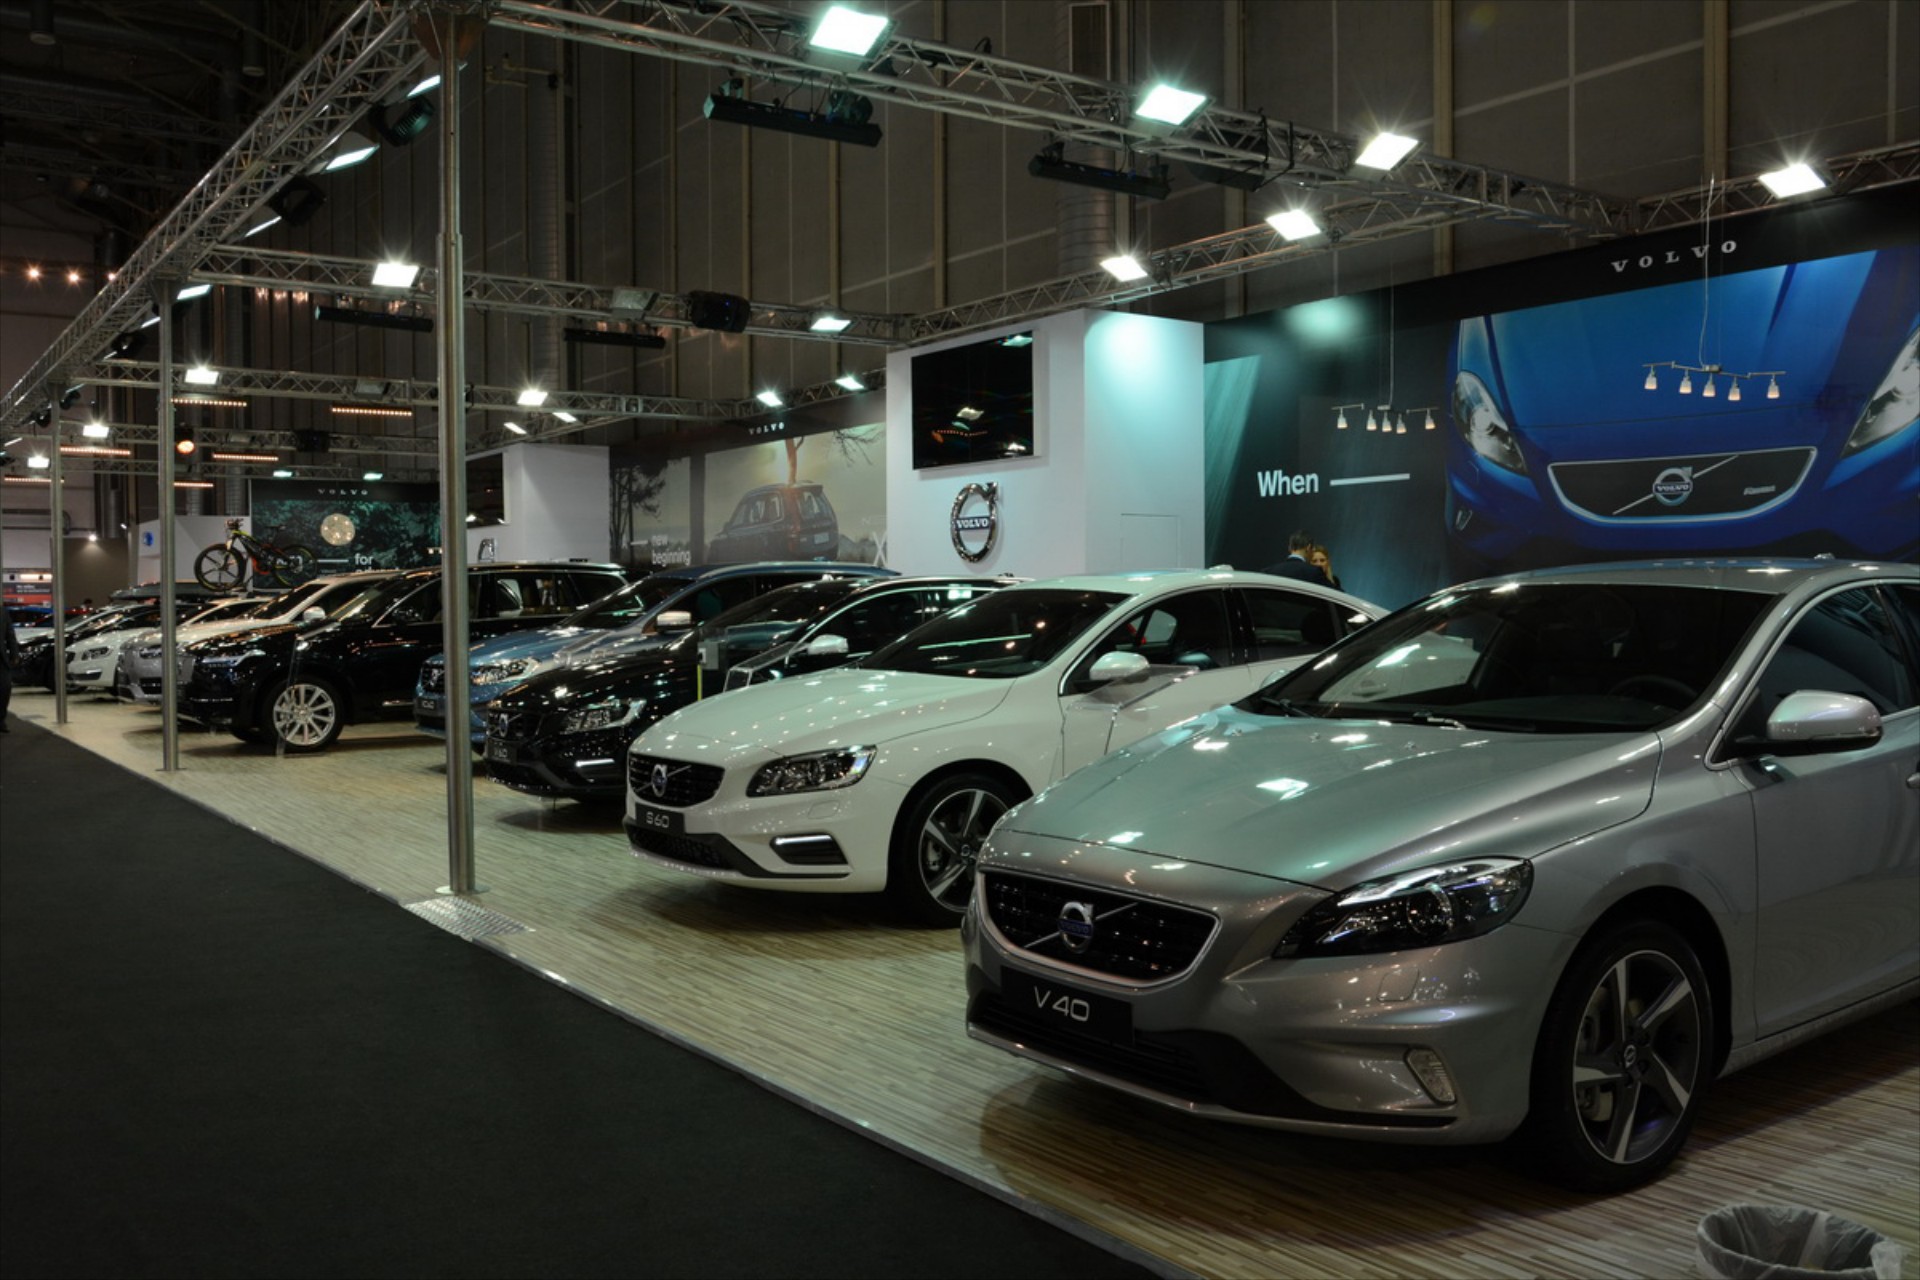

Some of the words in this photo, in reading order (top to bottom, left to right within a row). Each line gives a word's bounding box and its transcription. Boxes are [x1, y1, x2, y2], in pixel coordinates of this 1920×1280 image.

[1610, 239, 1738, 273] VOLVO
[747, 421, 785, 436] VOLVO
[1256, 468, 1319, 498] When
[1655, 483, 1690, 494] VOLVO
[317, 488, 369, 496] VOLVO
[955, 518, 989, 529] VOLVO
[354, 552, 374, 566] for
[651, 549, 691, 568] beginning
[645, 811, 670, 829] S60
